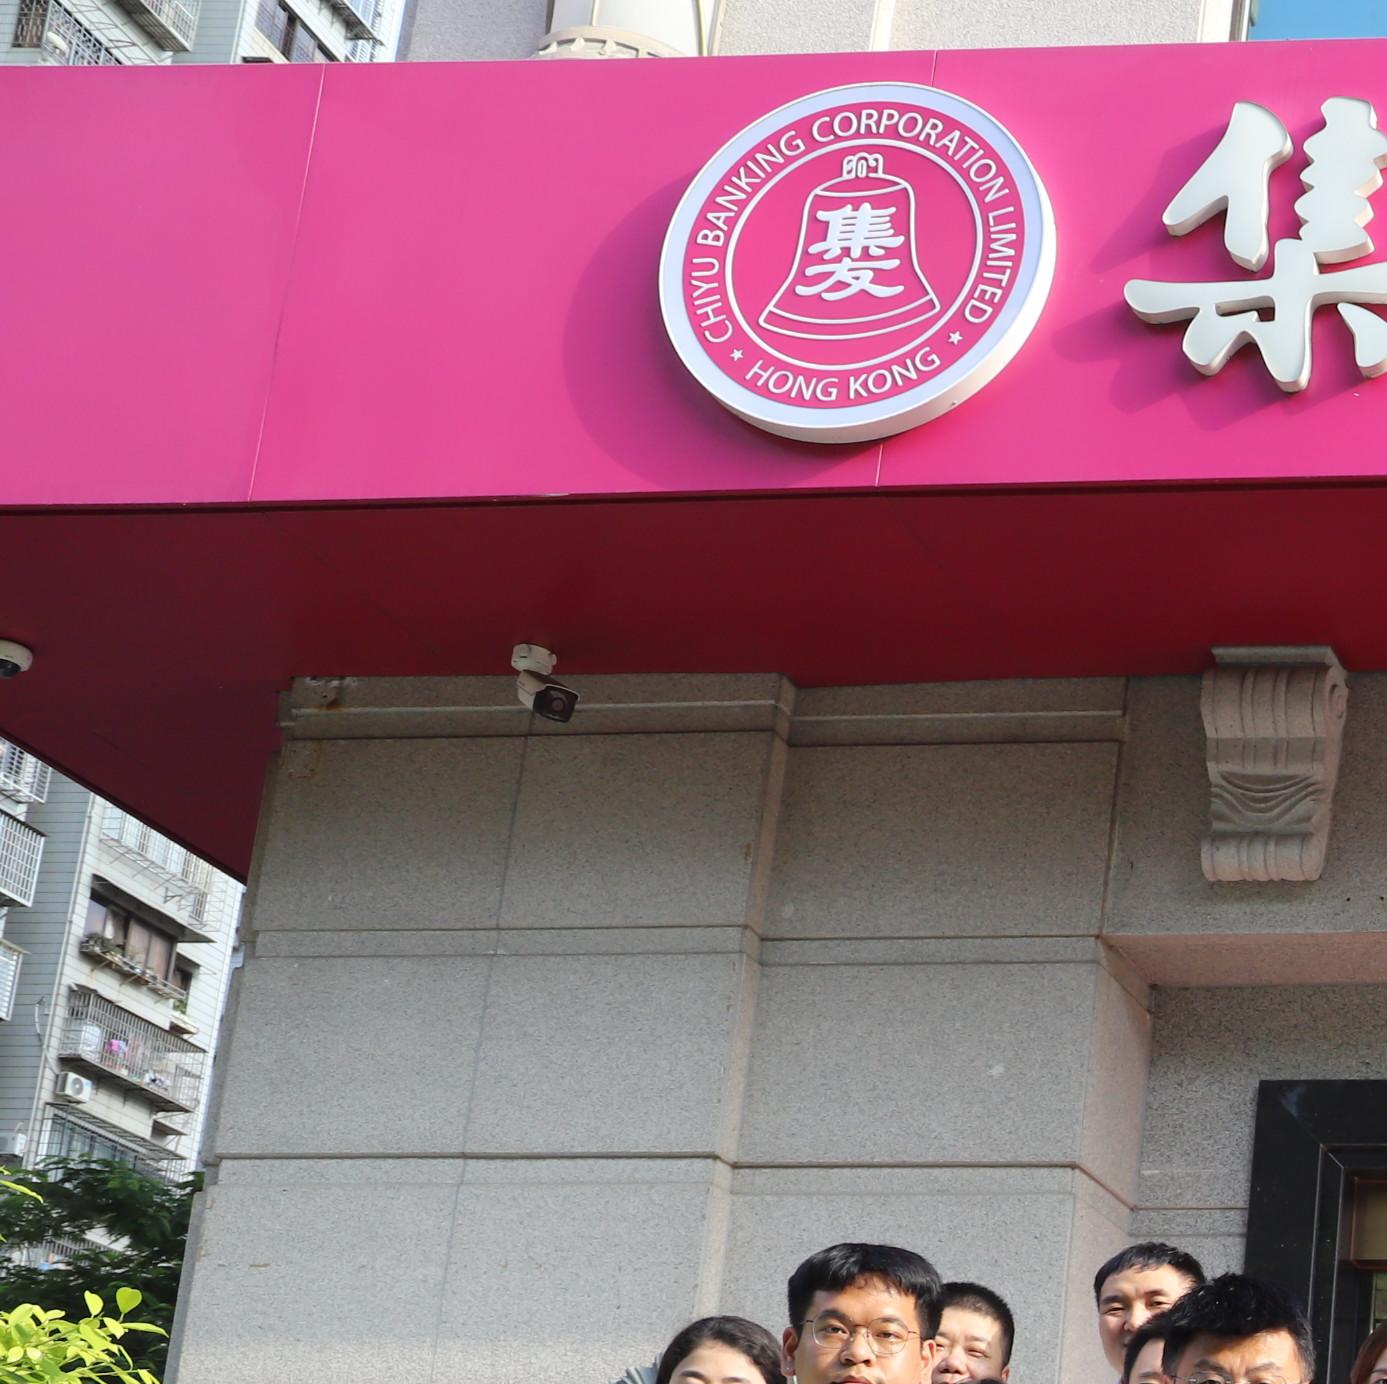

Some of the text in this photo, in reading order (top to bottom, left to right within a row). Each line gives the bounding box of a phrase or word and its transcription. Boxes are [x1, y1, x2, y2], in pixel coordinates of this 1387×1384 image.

[692, 108, 1017, 344] CHIYU BANKING CORPORATION LIMITED
[745, 346, 941, 401] HONG KONG
